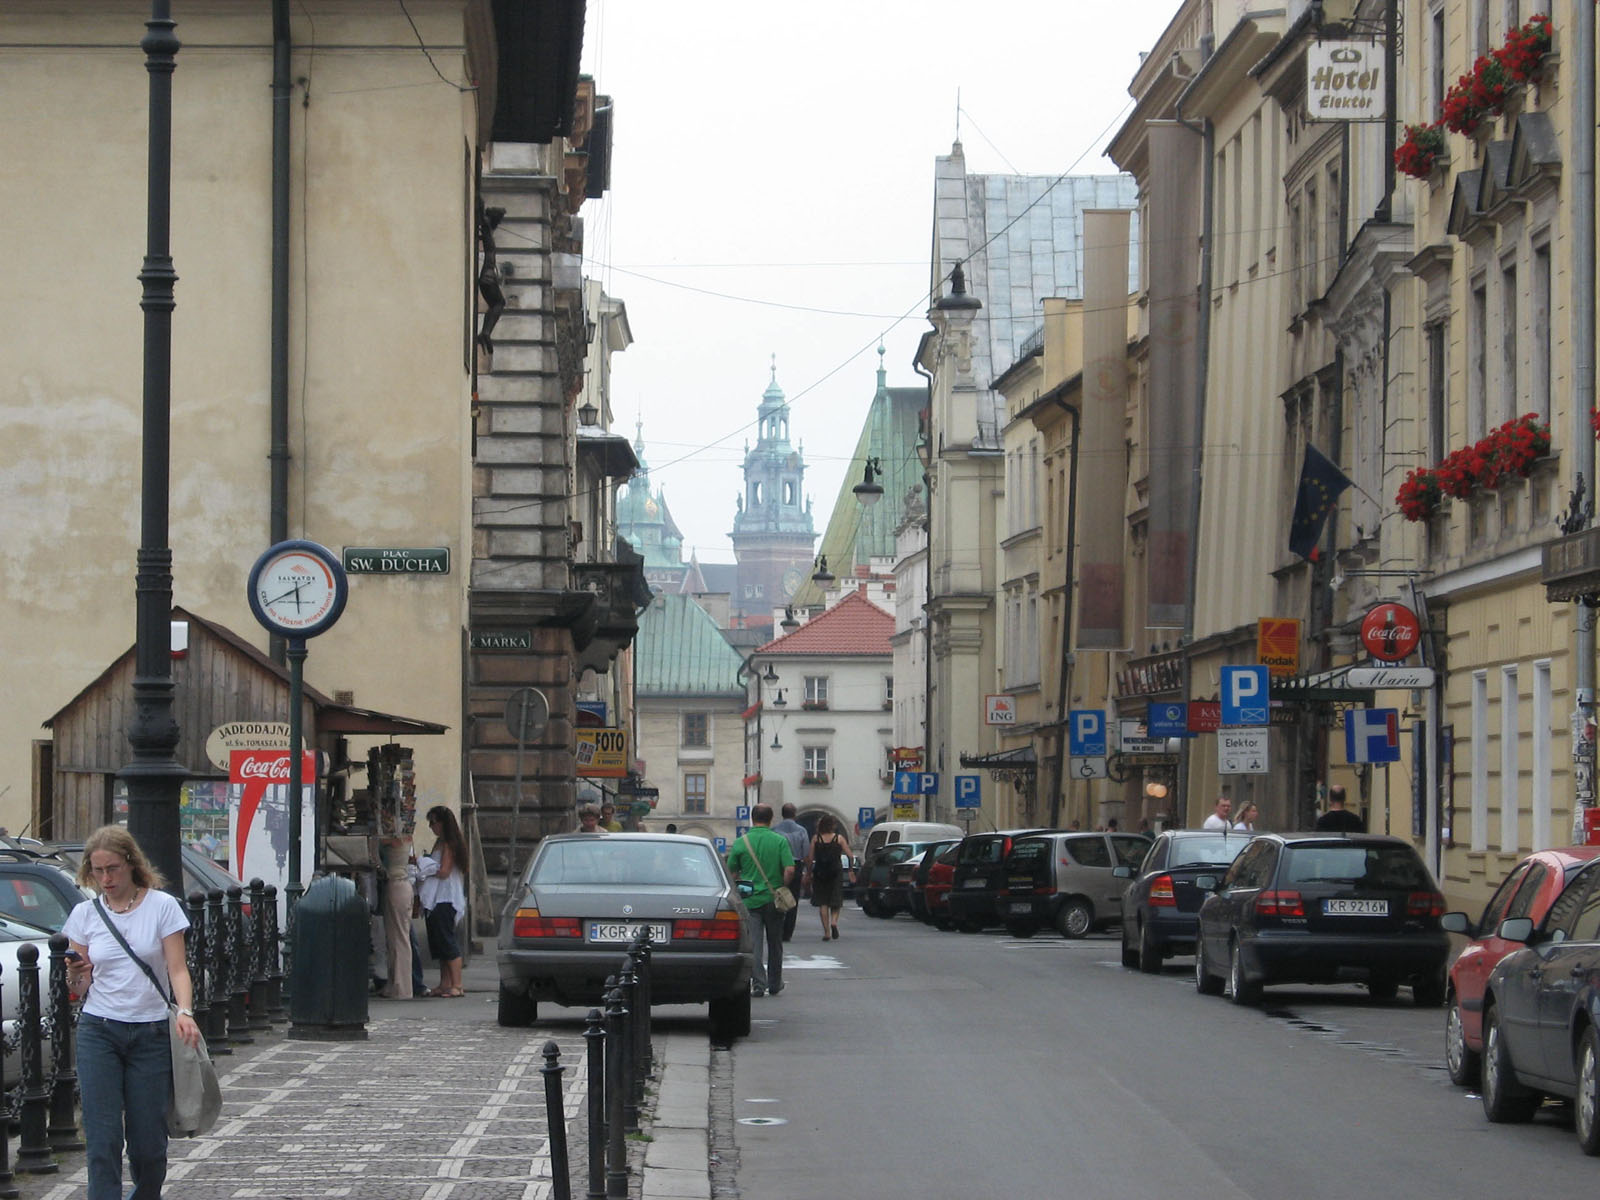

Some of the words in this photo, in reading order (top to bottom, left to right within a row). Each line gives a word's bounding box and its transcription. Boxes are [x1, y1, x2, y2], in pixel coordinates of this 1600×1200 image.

[1311, 66, 1379, 91] Hotel
[1319, 95, 1373, 108] Elektor
[383, 550, 410, 558] PLAC
[381, 558, 442, 572] DUCHA
[481, 637, 528, 648] MARKA
[1261, 655, 1296, 666] Kodak
[1359, 670, 1420, 687] Maria
[1231, 670, 1259, 708] P
[991, 711, 1013, 721] ING
[218, 724, 291, 739] JADŁODAJNI
[1077, 713, 1099, 743] P
[595, 732, 625, 752] FOTO
[1225, 738, 1258, 748] Elektor
[921, 774, 935, 793] P
[960, 778, 977, 799] P
[738, 807, 748, 819] P
[863, 809, 872, 823] P
[1329, 900, 1346, 912] KR
[1351, 900, 1387, 912] 9216W
[599, 926, 628, 939] KGR
[631, 926, 664, 939] 6SH
